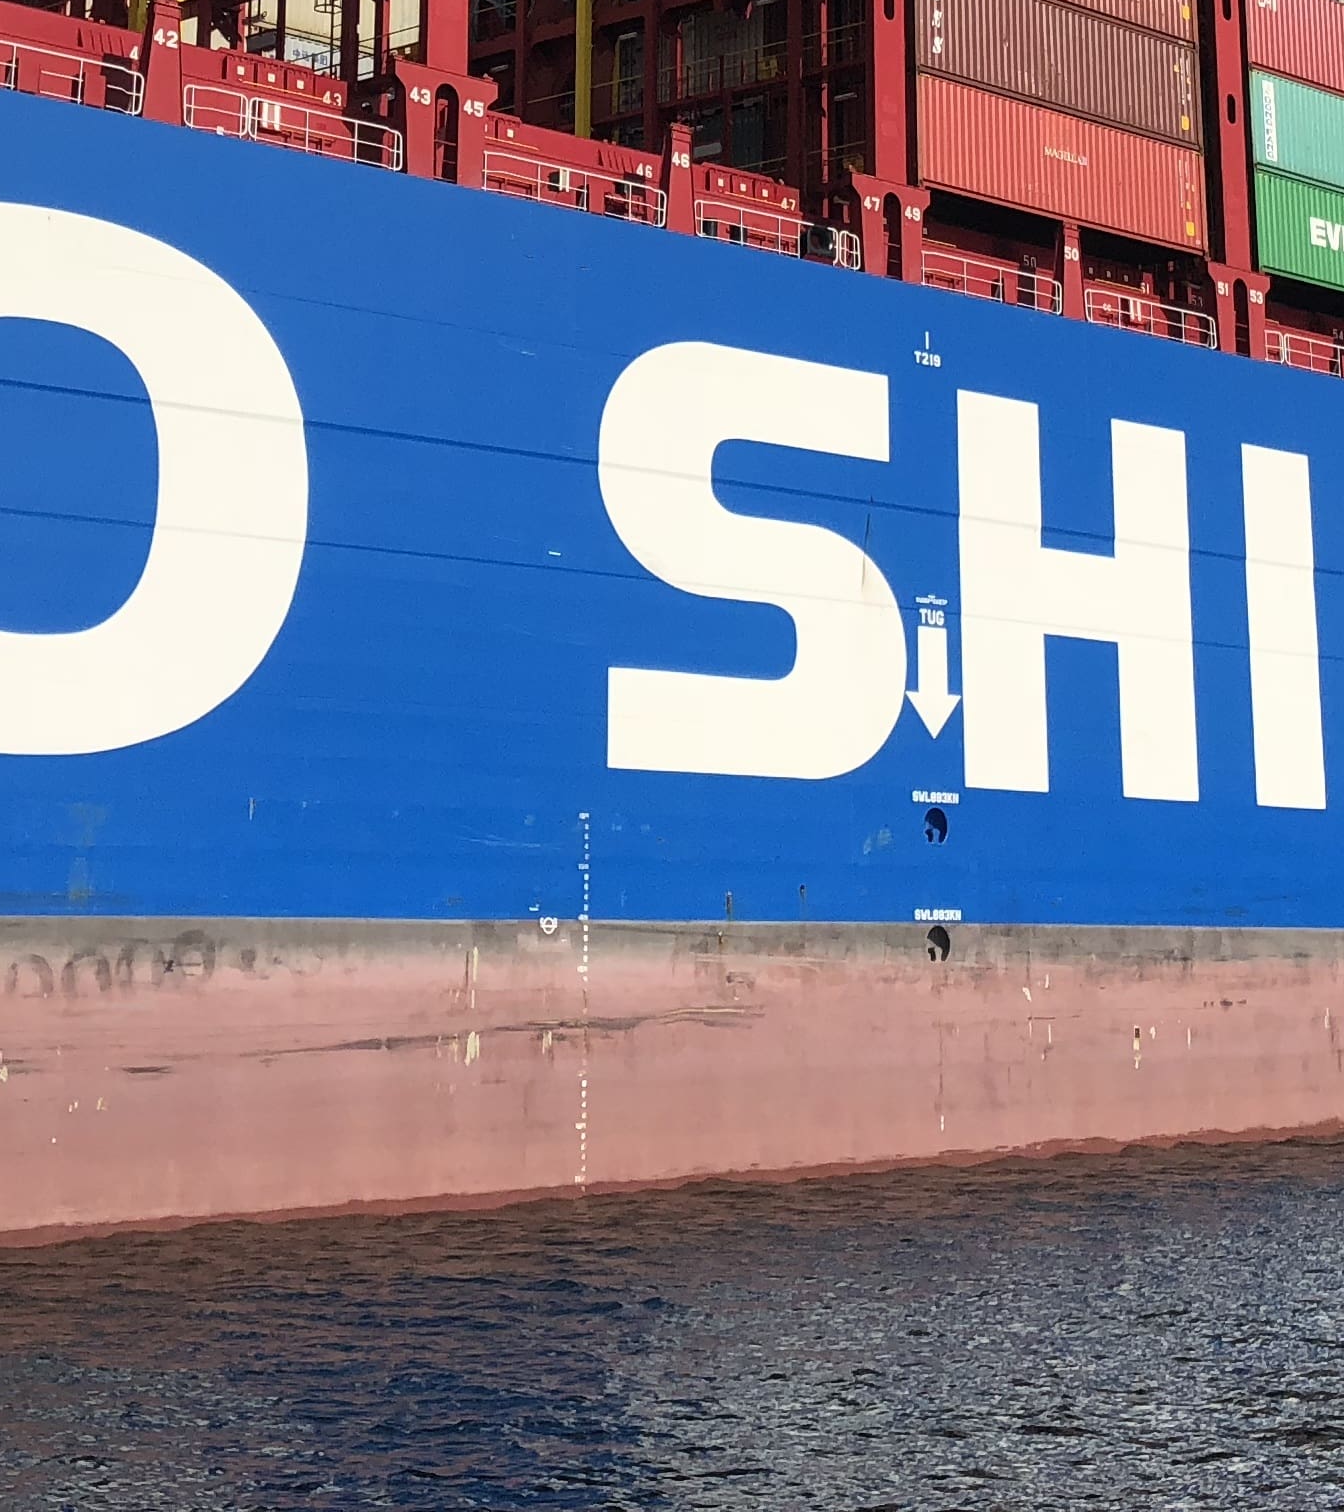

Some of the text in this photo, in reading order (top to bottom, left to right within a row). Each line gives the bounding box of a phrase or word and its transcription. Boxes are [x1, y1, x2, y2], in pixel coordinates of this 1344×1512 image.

[153, 29, 179, 49] 42
[129, 46, 139, 61] 4
[322, 91, 342, 107] 43
[409, 86, 431, 106] 43
[463, 99, 484, 118] 45
[671, 151, 690, 169] 46
[636, 163, 653, 179] 46
[781, 198, 797, 211] 47
[863, 197, 880, 212] 47
[904, 206, 921, 221] 49
[1023, 254, 1037, 268] 50
[1064, 246, 1079, 262] 50
[1217, 281, 1229, 297] 51
[1250, 289, 1264, 305] 53
[913, 349, 942, 368] T219
[919, 608, 945, 626] TUG
